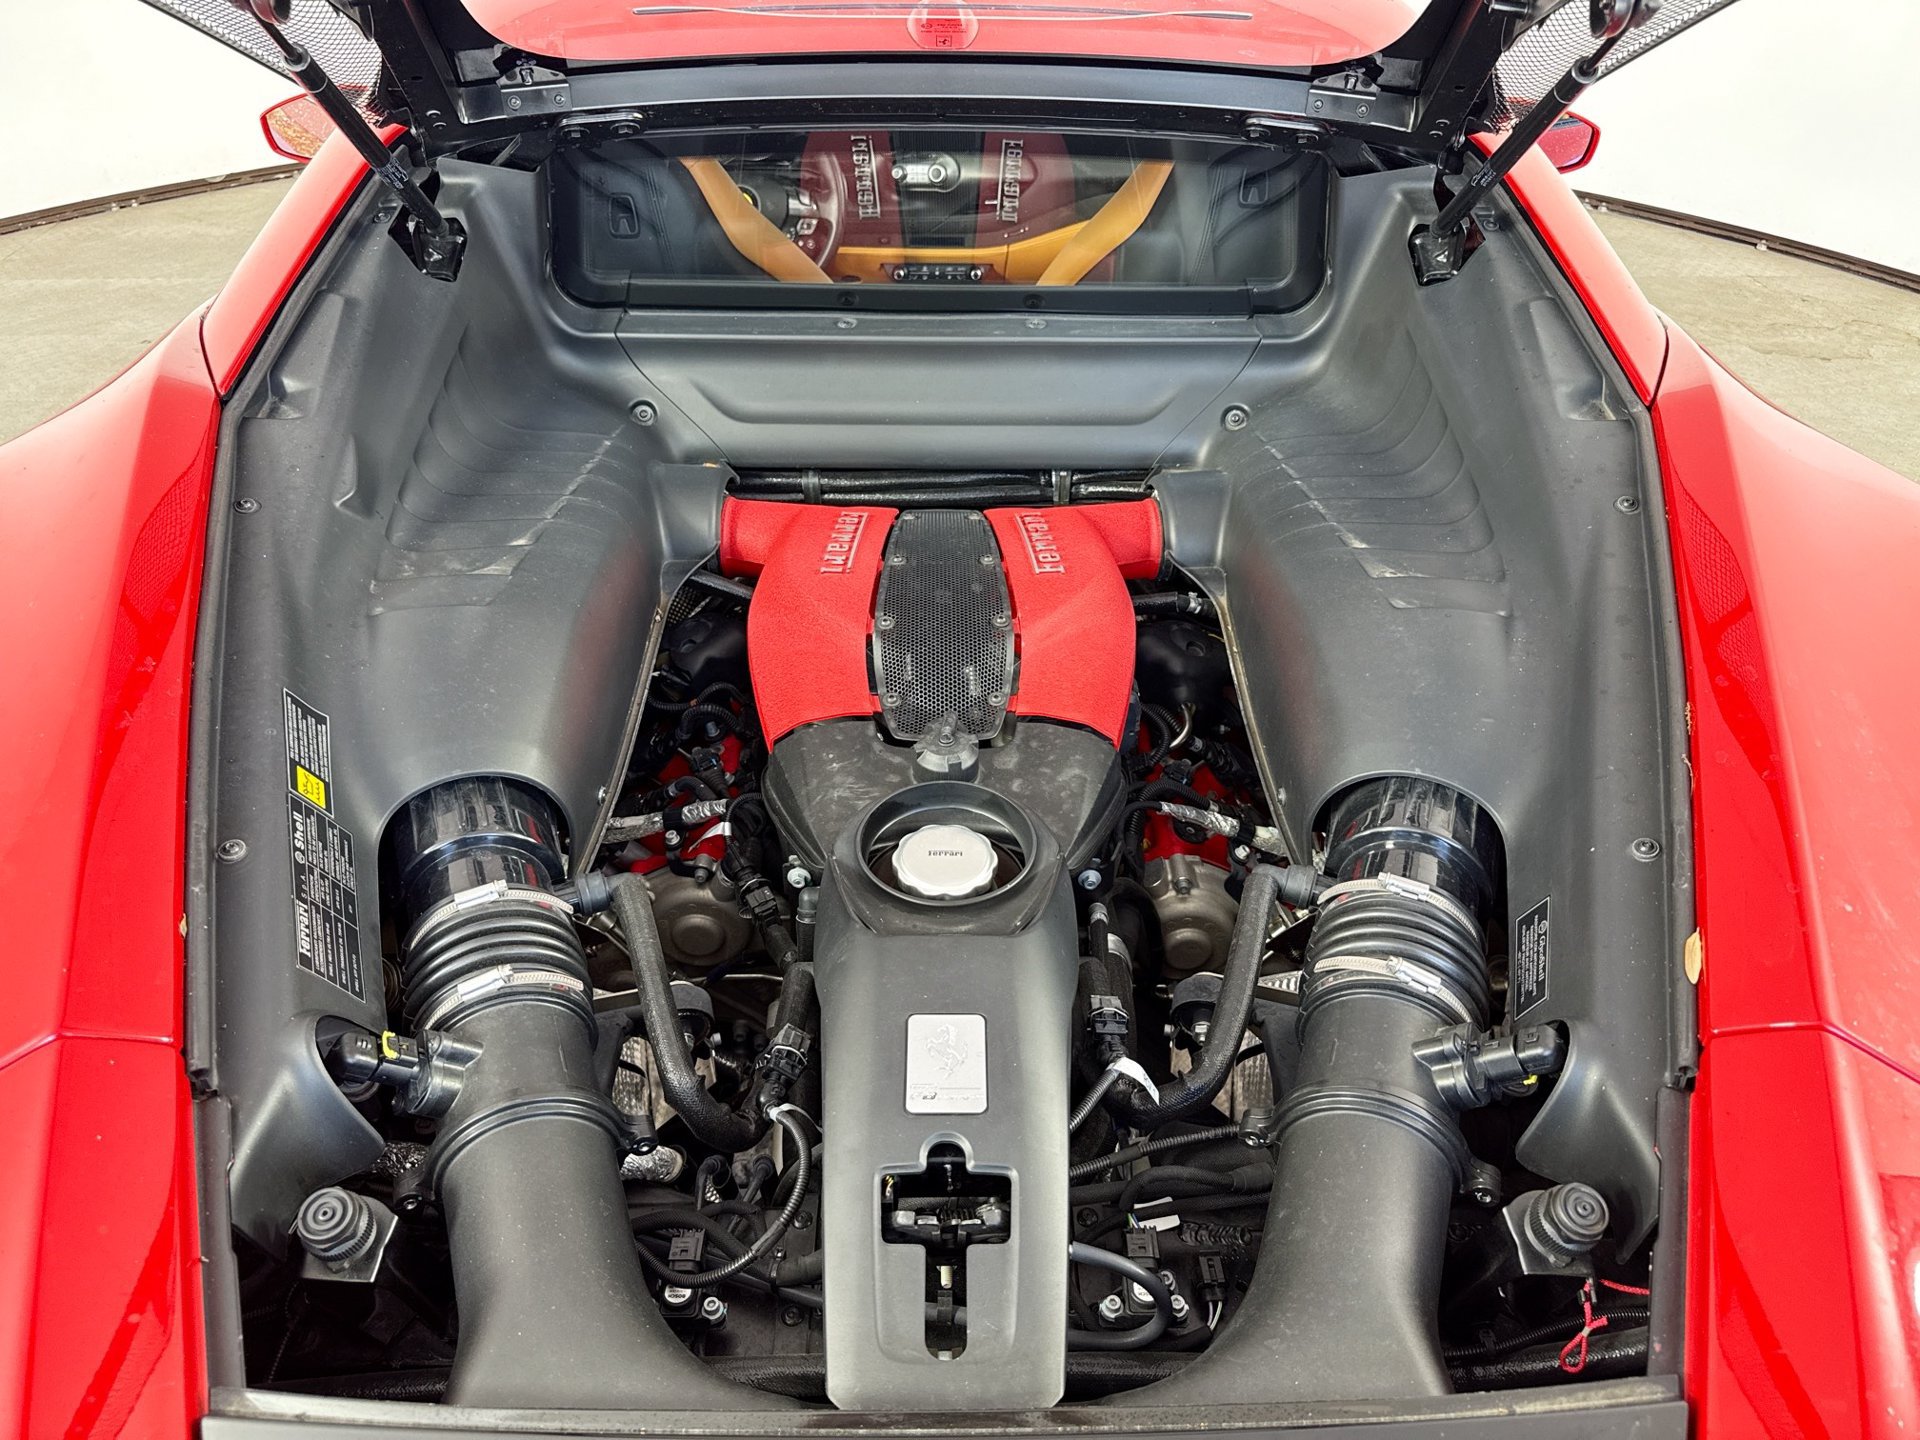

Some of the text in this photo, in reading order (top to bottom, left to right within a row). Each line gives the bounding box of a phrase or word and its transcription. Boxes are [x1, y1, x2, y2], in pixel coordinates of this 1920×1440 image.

[820, 511, 868, 574] Ferrari
[1015, 511, 1065, 575] Ferrari
[293, 810, 304, 850] Shell
[297, 900, 311, 958] Ferrari
[1538, 936, 1546, 981] GlycoShell
